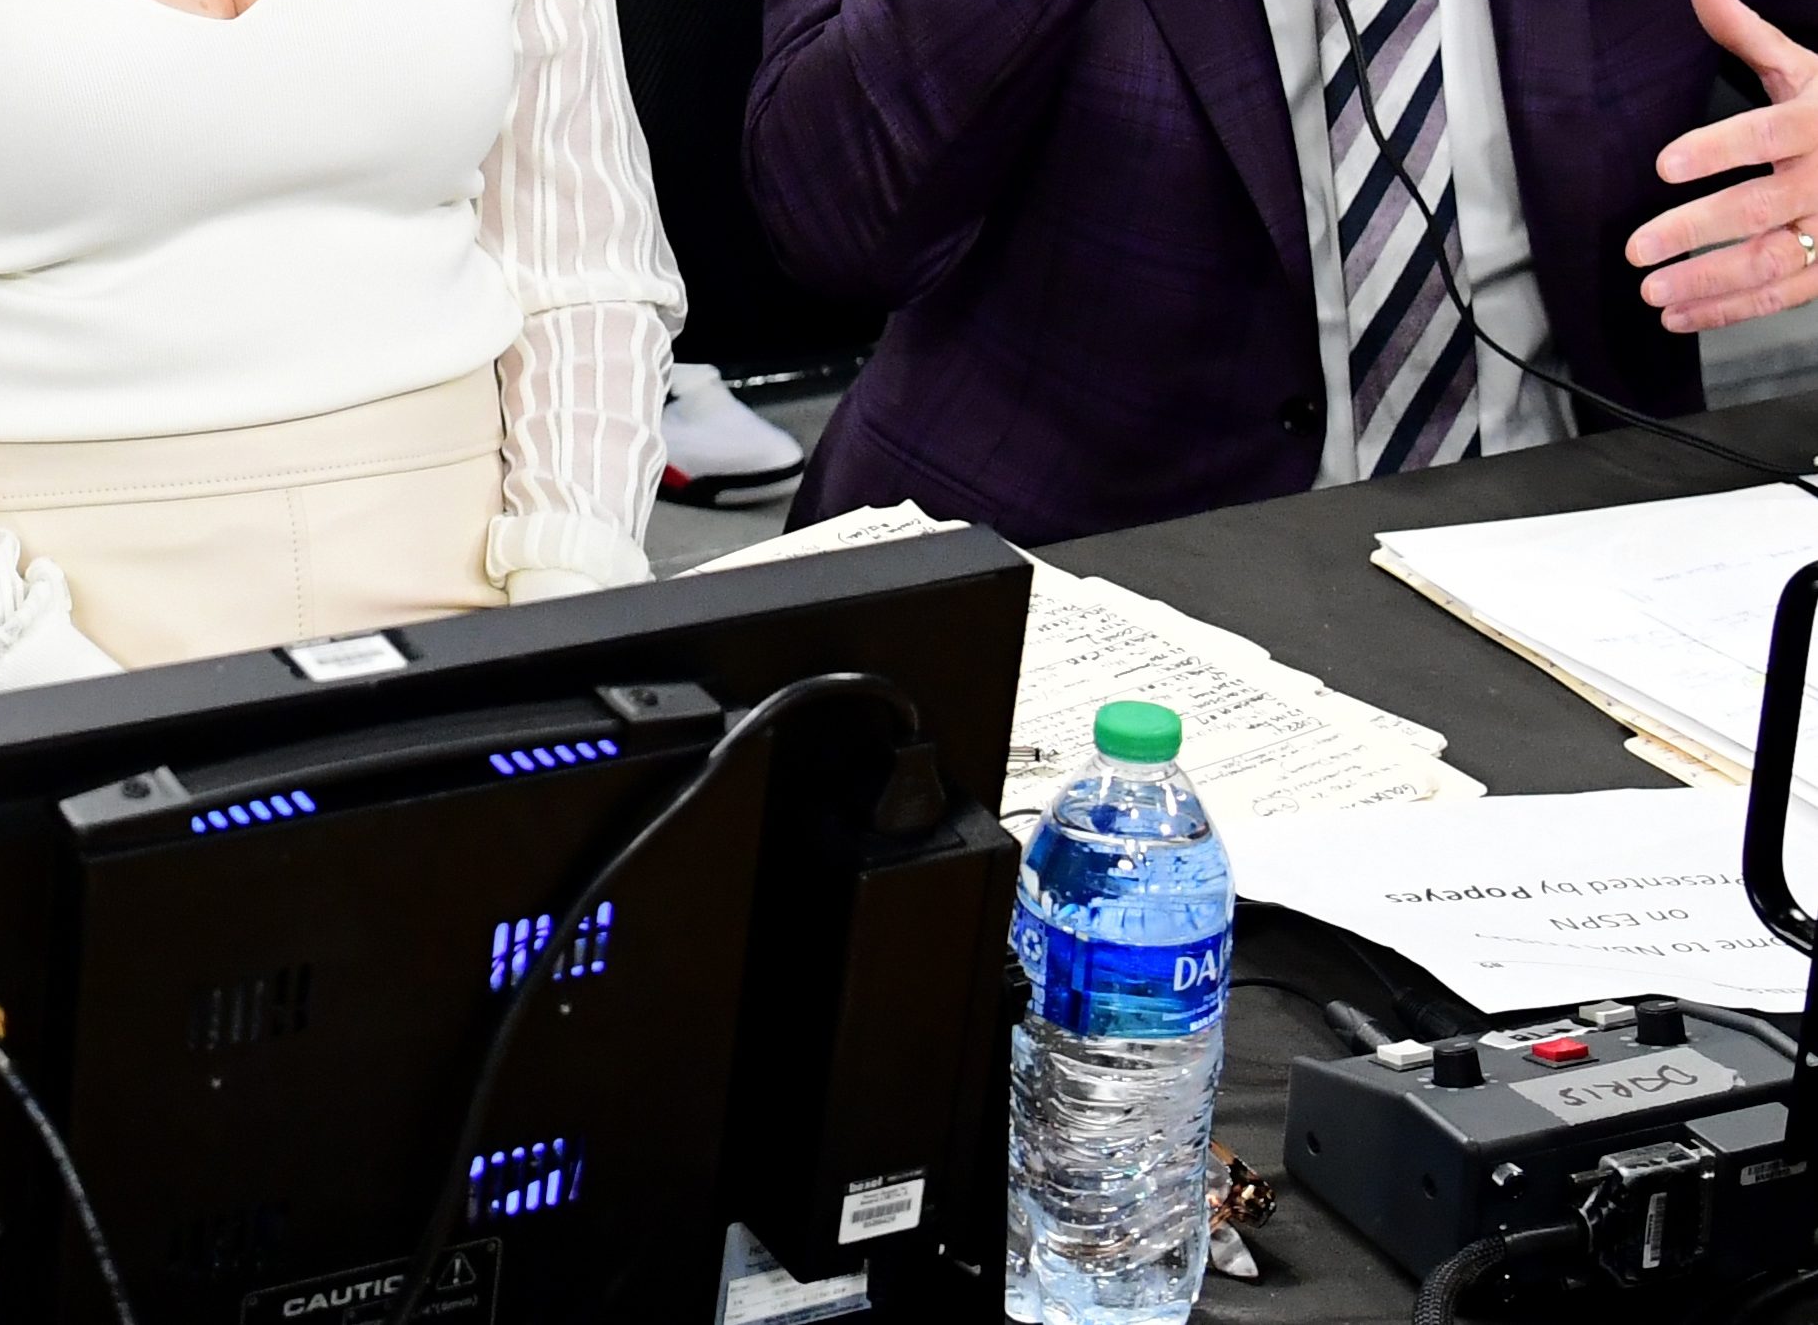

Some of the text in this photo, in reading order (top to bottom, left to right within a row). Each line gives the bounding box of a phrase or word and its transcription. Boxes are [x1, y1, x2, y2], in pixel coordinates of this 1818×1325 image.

[1385, 884, 1532, 904] Popeyes
[1540, 879, 1579, 896] by
[1549, 907, 1689, 931] on ESPN
[1671, 938, 1709, 955] to
[1558, 1064, 1698, 1106] DORIS
